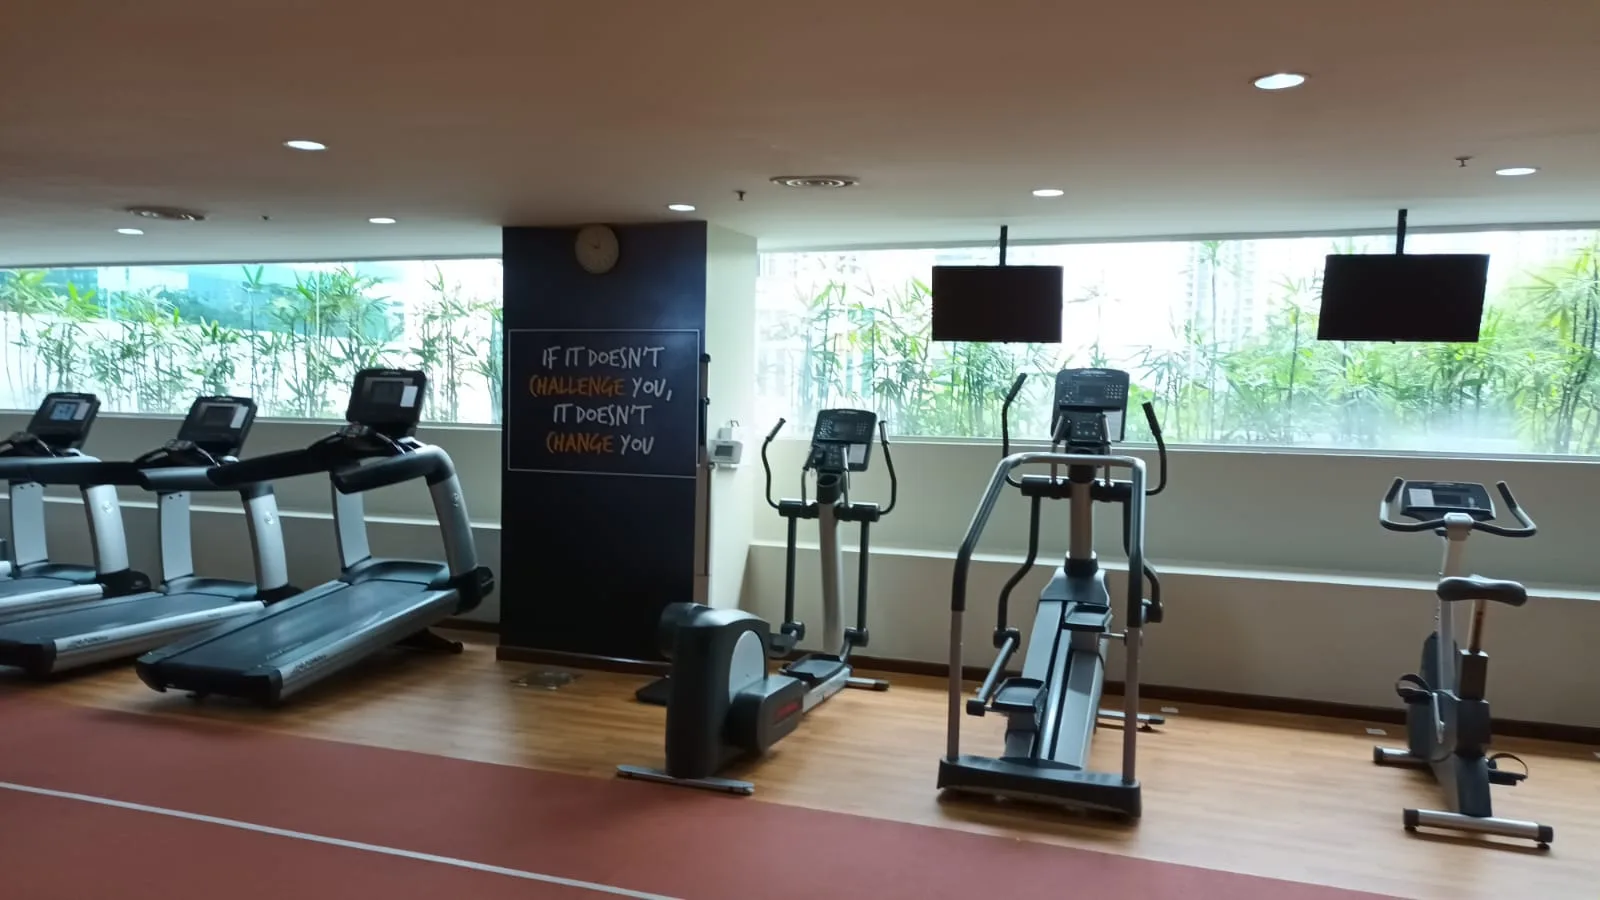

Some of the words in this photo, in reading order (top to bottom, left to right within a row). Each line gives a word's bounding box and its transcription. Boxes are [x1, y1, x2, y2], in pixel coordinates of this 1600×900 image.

[542, 346, 561, 369] IF
[565, 346, 585, 367] IT
[588, 346, 664, 369] DOESN'T
[529, 374, 626, 397] CHALLENGE
[632, 377, 672, 401] YOU,
[553, 403, 573, 423] IT
[576, 404, 652, 426] DOESN'T
[546, 431, 614, 453] CHANGE
[620, 434, 654, 455] YOU
